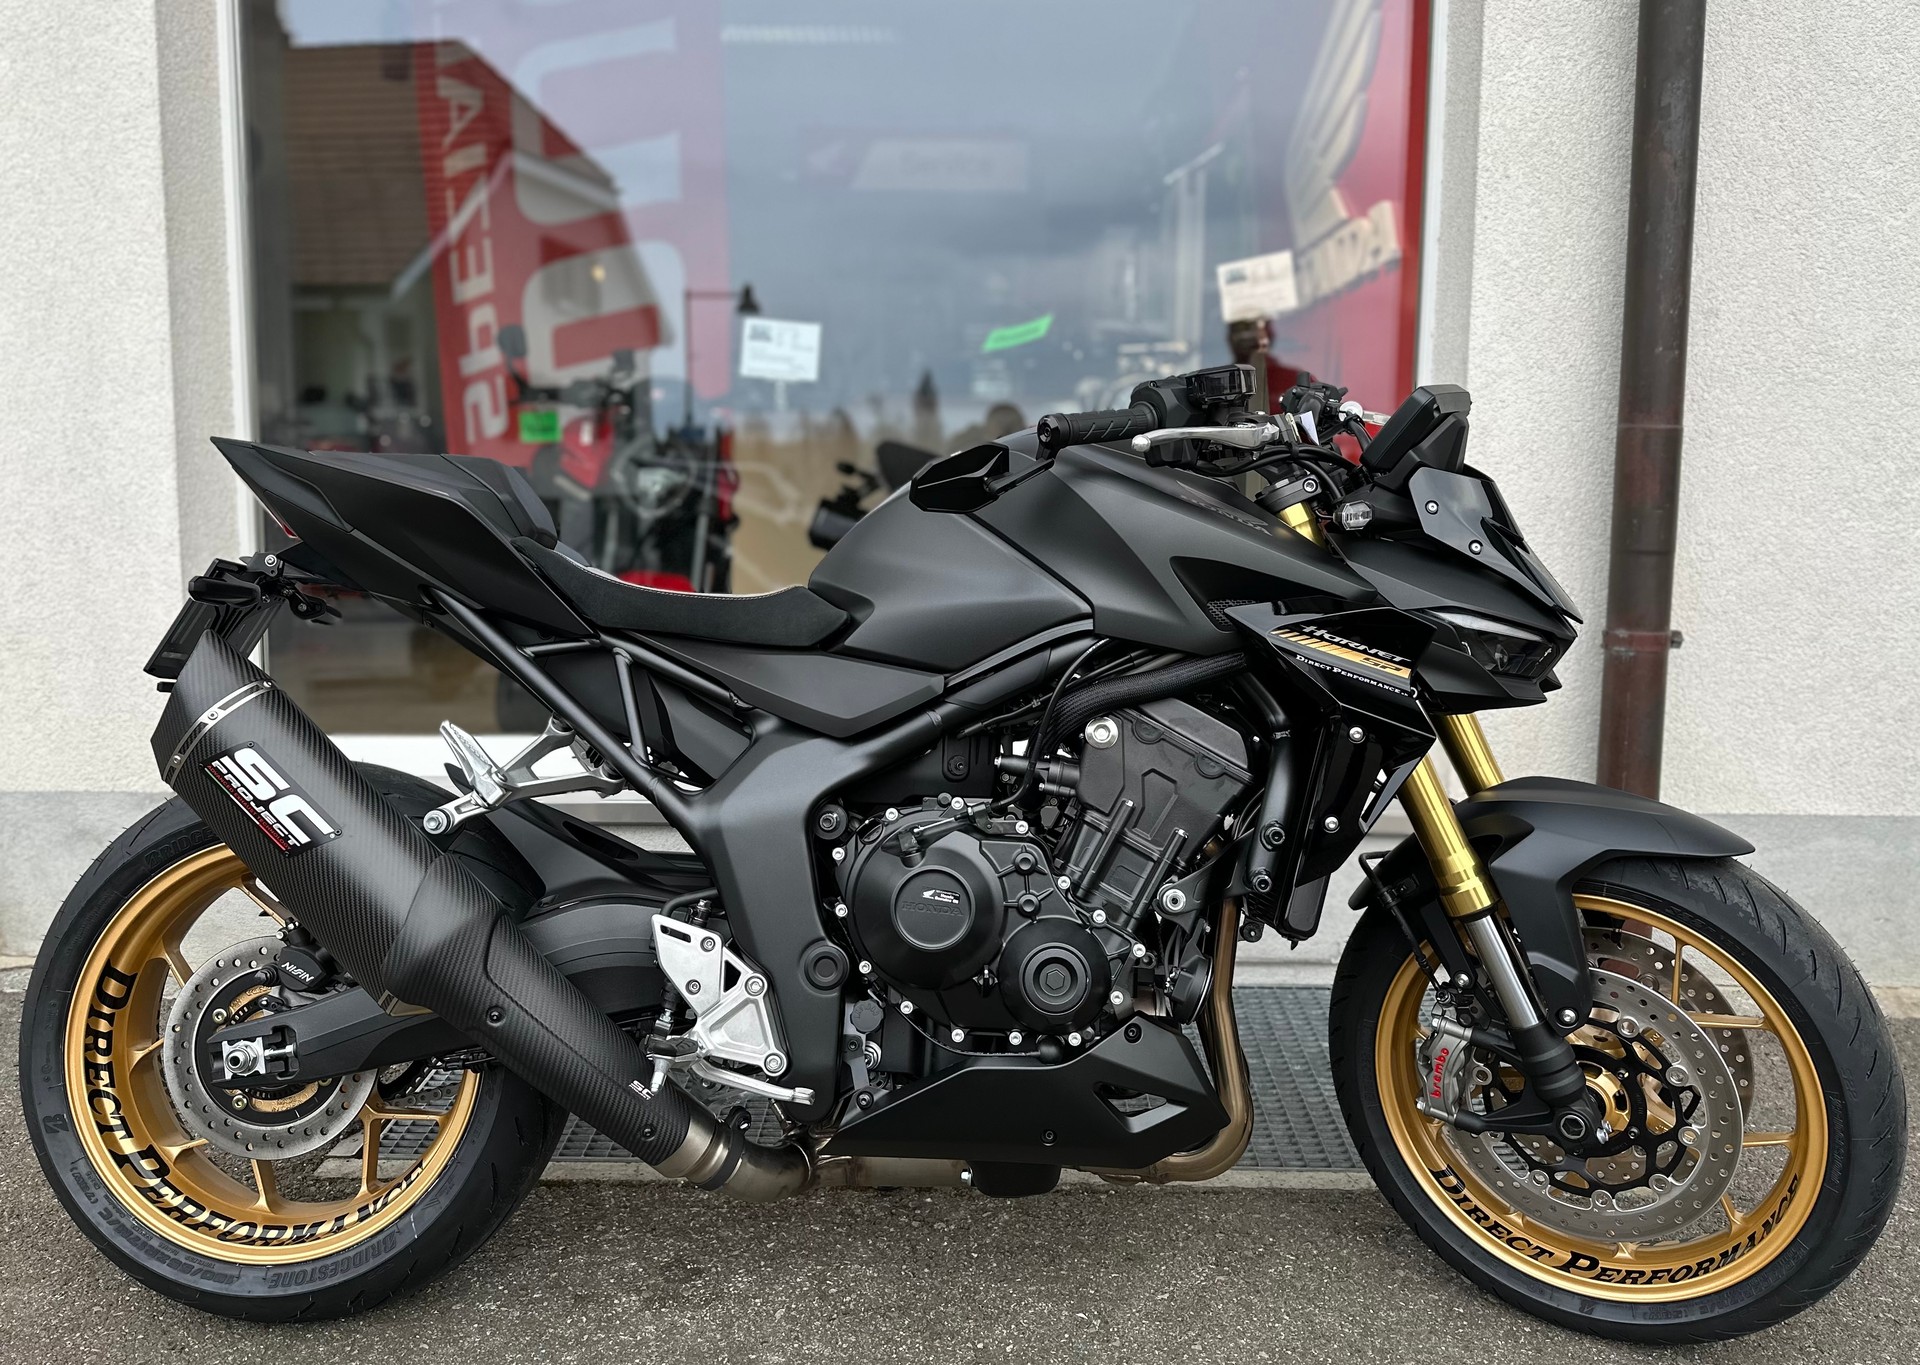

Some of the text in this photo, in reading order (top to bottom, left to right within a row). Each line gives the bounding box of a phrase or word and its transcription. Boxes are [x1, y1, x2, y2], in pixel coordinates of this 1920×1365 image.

[1296, 654, 1331, 671] DIRECT
[1360, 656, 1403, 672] SP
[207, 764, 234, 794] ADVANCED
[211, 760, 301, 847] PROJECT
[219, 747, 335, 845] SC
[901, 900, 964, 917] HONDA
[84, 958, 138, 1140] DIRECT
[1430, 1047, 1450, 1100] brembo
[1428, 1163, 1799, 1286] DIRECT PERFORMANCE
[267, 1229, 397, 1290] BRIDGESTONE
